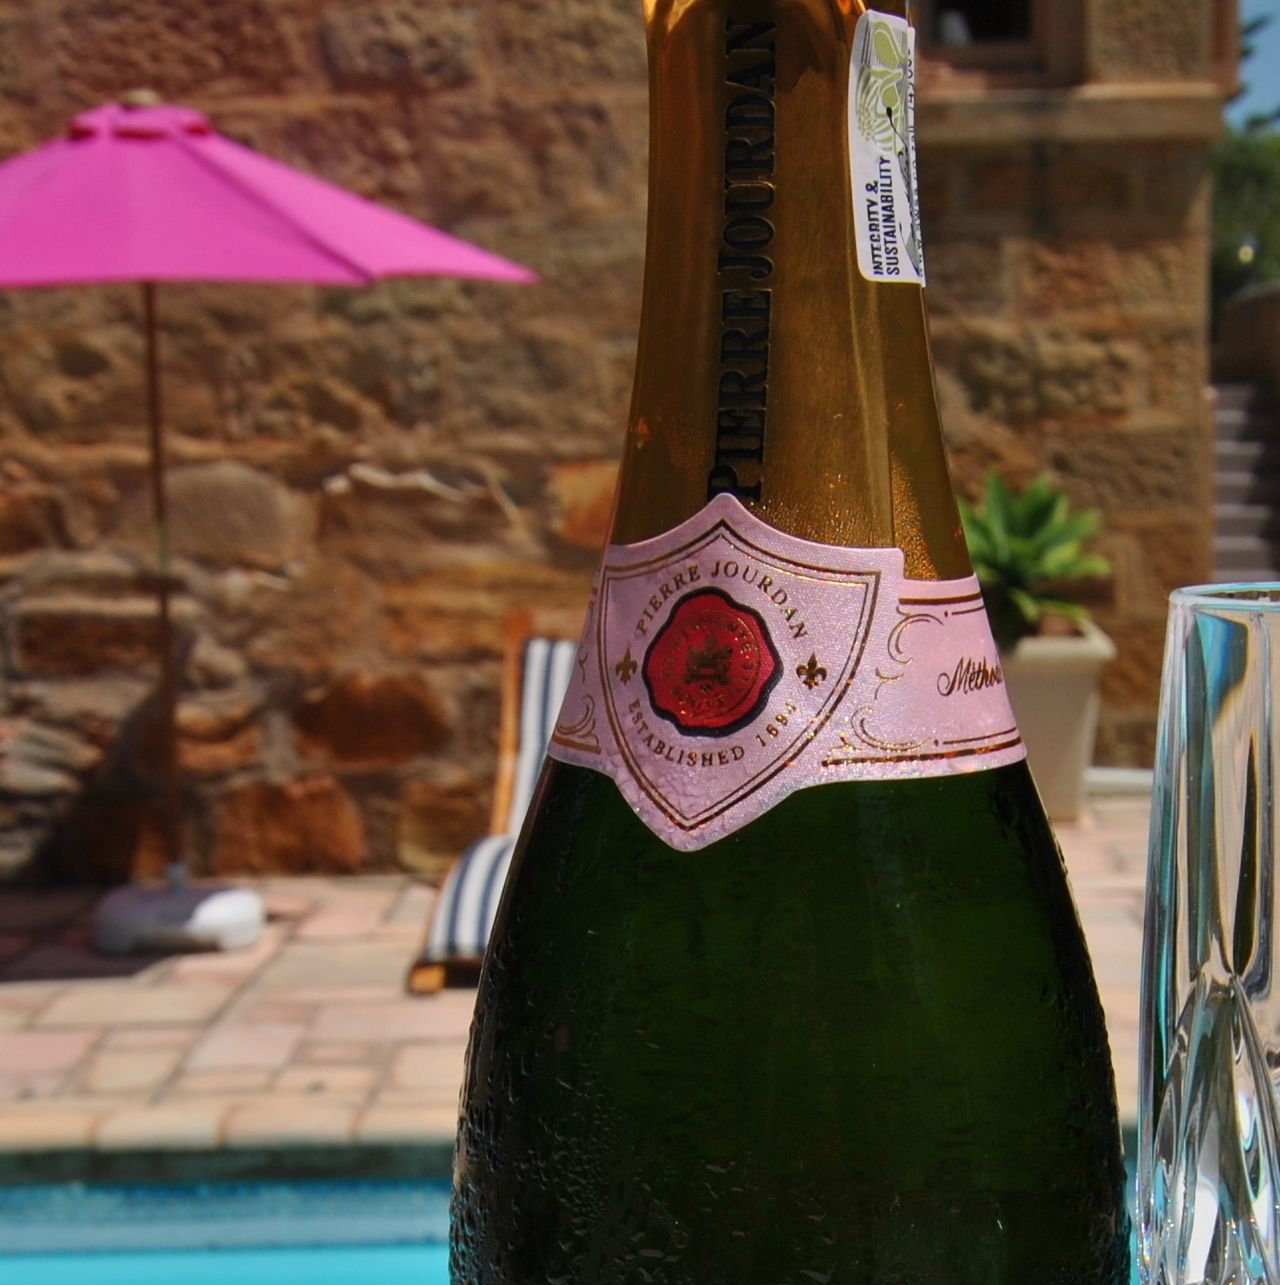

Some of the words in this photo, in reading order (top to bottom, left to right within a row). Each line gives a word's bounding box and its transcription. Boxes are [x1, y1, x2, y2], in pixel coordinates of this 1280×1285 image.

[718, 19, 776, 281] JOURDAN
[865, 180, 878, 194] &
[879, 156, 900, 276] SUSTAINABILITY
[708, 288, 773, 500] PIERRE
[636, 564, 701, 635] PIERRE
[711, 560, 808, 640] JOURDAN
[628, 699, 745, 767] ESTABLISHED
